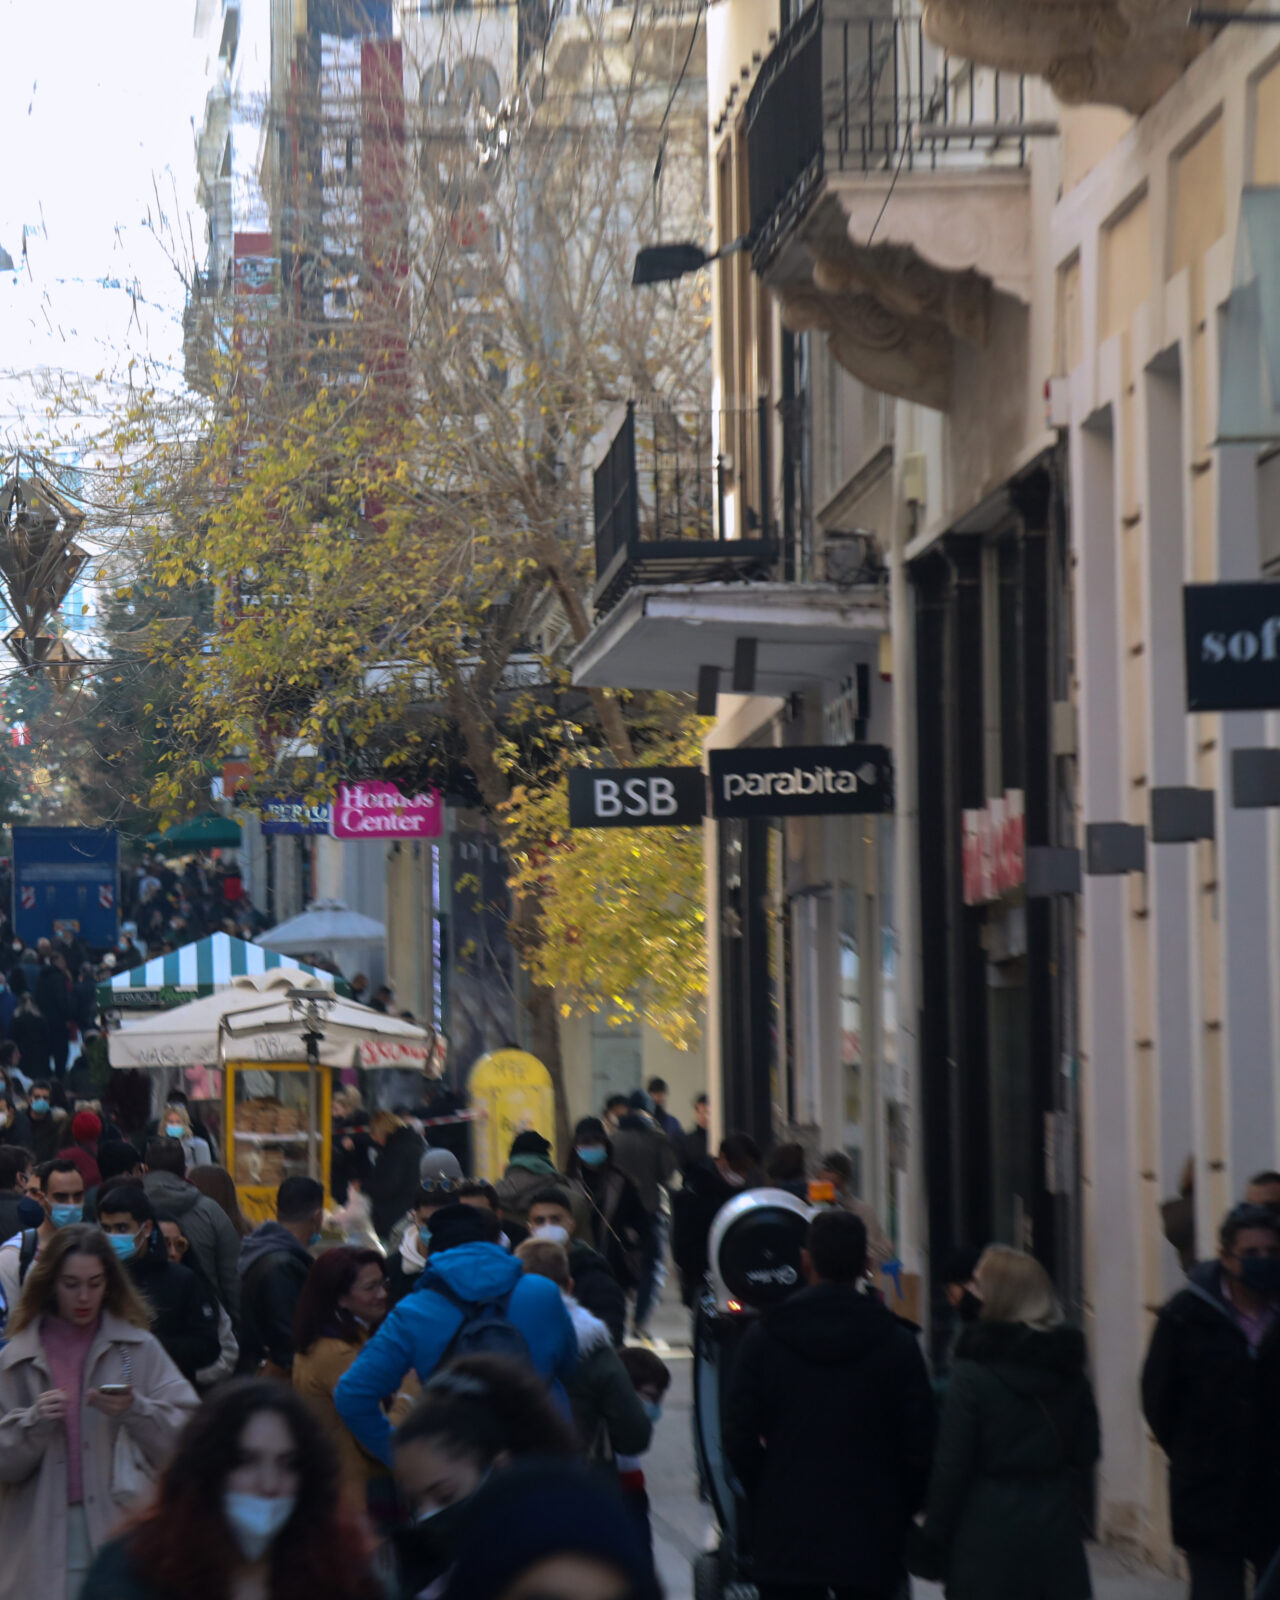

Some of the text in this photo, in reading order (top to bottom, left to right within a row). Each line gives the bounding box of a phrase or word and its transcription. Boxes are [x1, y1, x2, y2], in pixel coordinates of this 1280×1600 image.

[593, 777, 678, 817] BSB
[723, 765, 858, 801] parabita
[341, 809, 425, 832] Center
